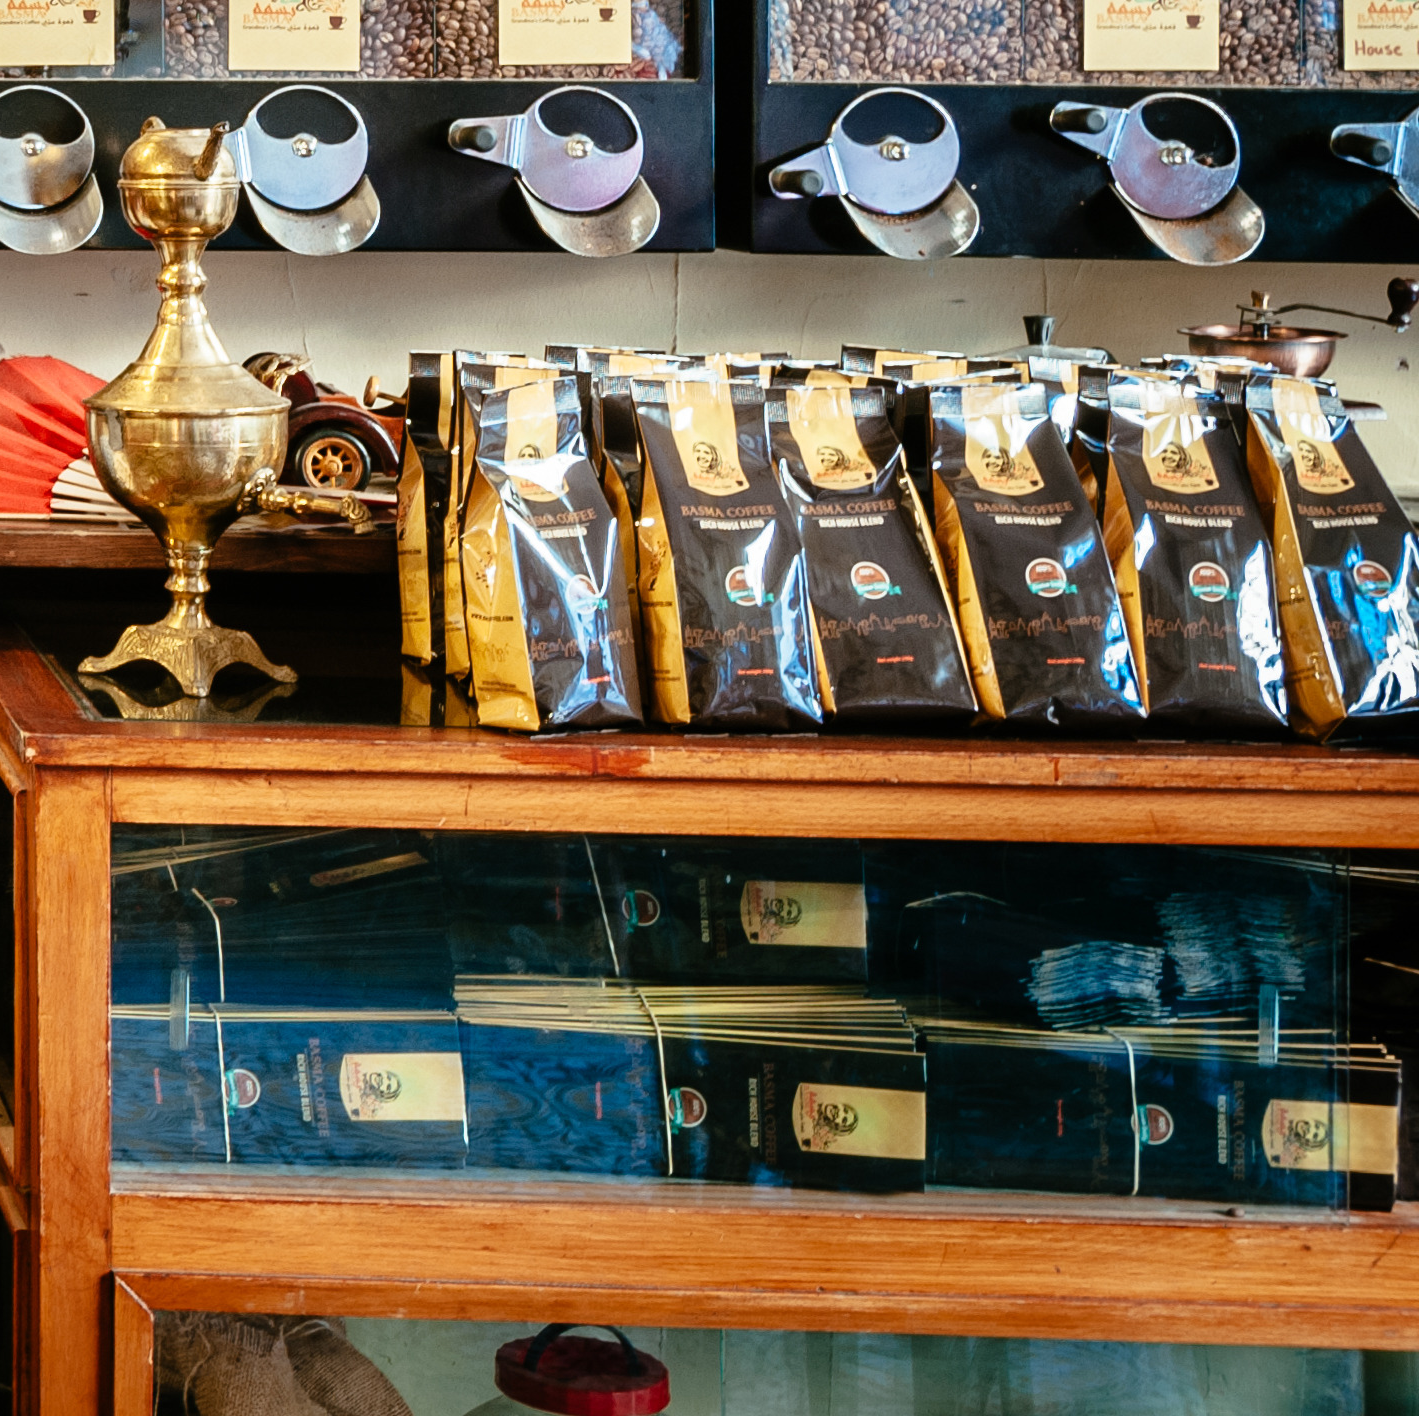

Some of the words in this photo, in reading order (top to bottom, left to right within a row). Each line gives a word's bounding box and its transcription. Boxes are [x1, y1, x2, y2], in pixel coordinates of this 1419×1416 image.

[1354, 39, 1403, 57] House
[681, 505, 725, 518] BASMA
[727, 504, 777, 516] COFFEE
[847, 498, 897, 513] COFFEE
[974, 501, 1021, 514] BASMA
[1022, 500, 1073, 514] COFFEE
[1146, 499, 1191, 515] BASMA
[1194, 502, 1245, 517] COFFEE
[1297, 503, 1336, 517] BASMA
[1338, 501, 1387, 515] COFFEE
[308, 1037, 323, 1085] BASMA
[763, 1063, 775, 1110] BASMA
[314, 1087, 330, 1138] COFFEE
[1233, 1080, 1245, 1127] BASMA
[765, 1114, 777, 1165] COFFEE
[1233, 1131, 1246, 1181] COFFEE
